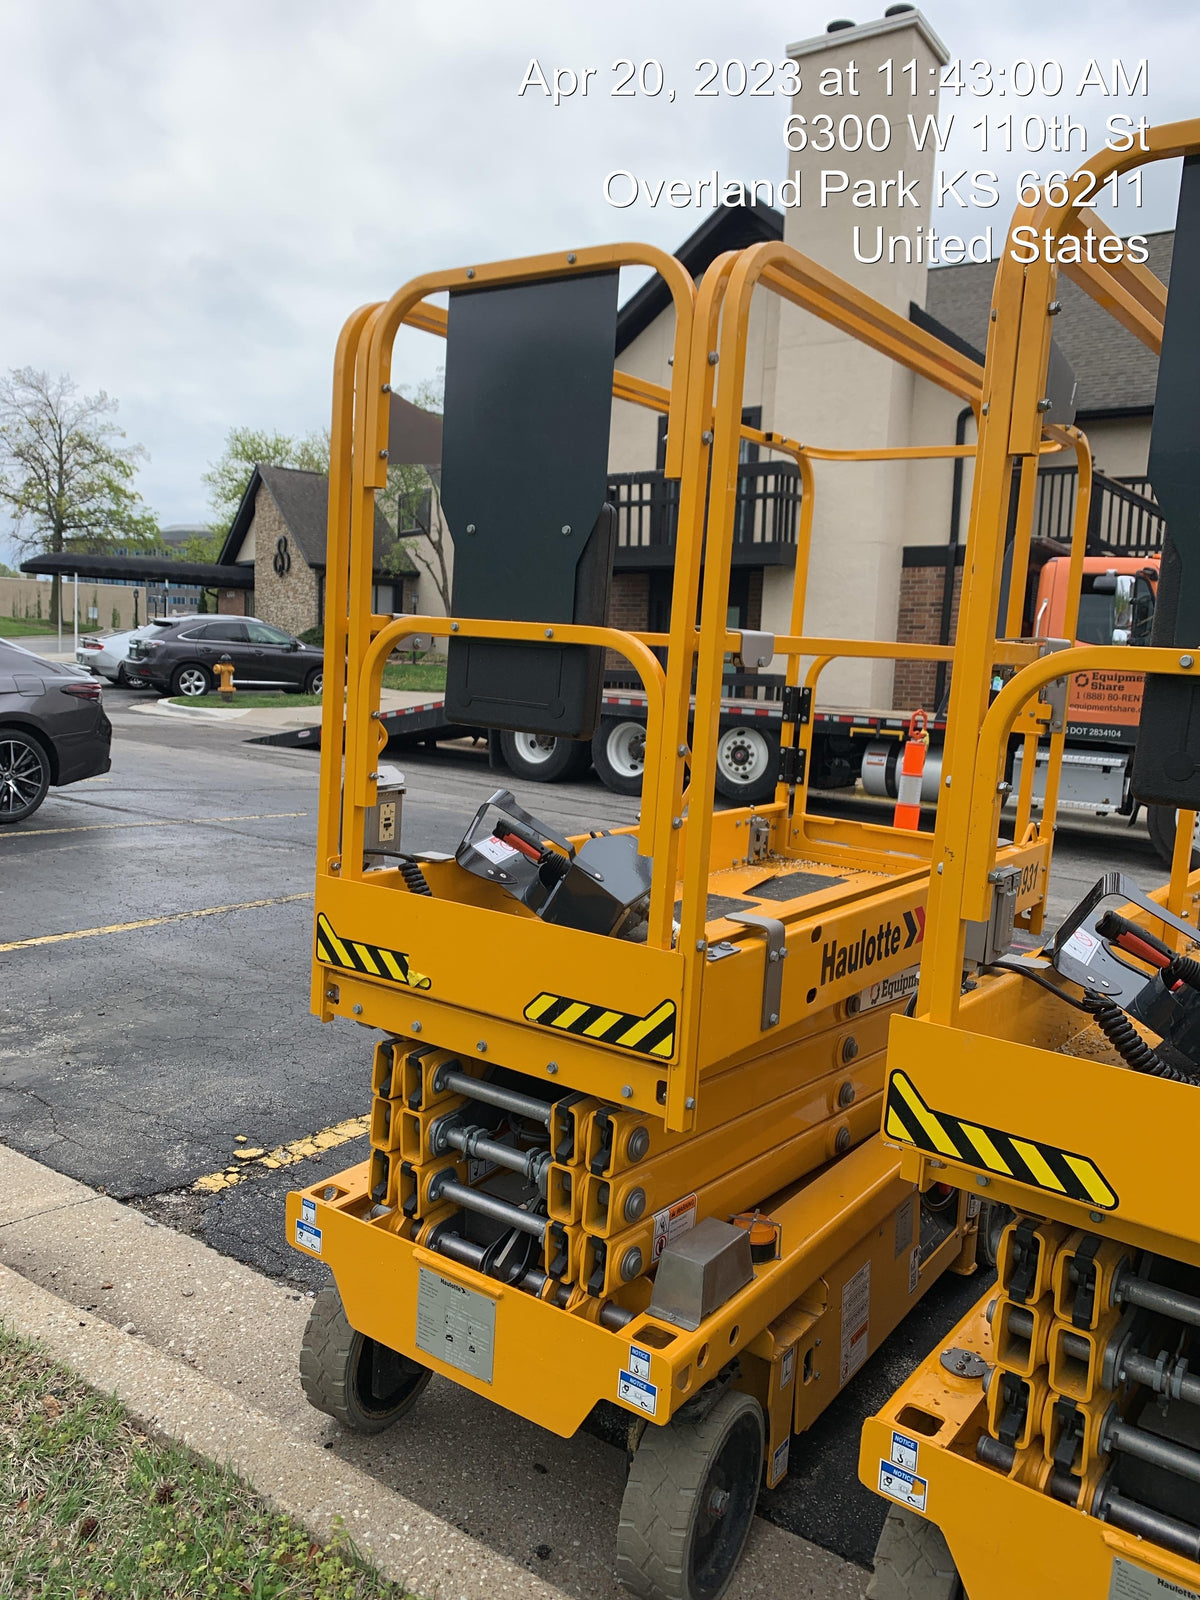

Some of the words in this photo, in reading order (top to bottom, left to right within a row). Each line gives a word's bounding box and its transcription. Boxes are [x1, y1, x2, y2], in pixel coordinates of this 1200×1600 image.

[1092, 671, 1144, 683] Equipme
[1091, 682, 1125, 691] Share
[1076, 691, 1080, 699] 1
[1083, 692, 1105, 700] (888)
[1107, 693, 1143, 702] 80-REN
[1070, 727, 1088, 735] DOT
[1089, 728, 1121, 738] 2834104
[820, 921, 901, 986] Haulotte
[440, 1278, 461, 1292] Haulotte
[631, 1347, 649, 1360] NOTICE
[629, 1377, 648, 1391] NOTICE
[894, 1434, 915, 1449] NOTICE
[892, 1468, 914, 1484] NOTICE
[1157, 1577, 1197, 1600] Haulotte
